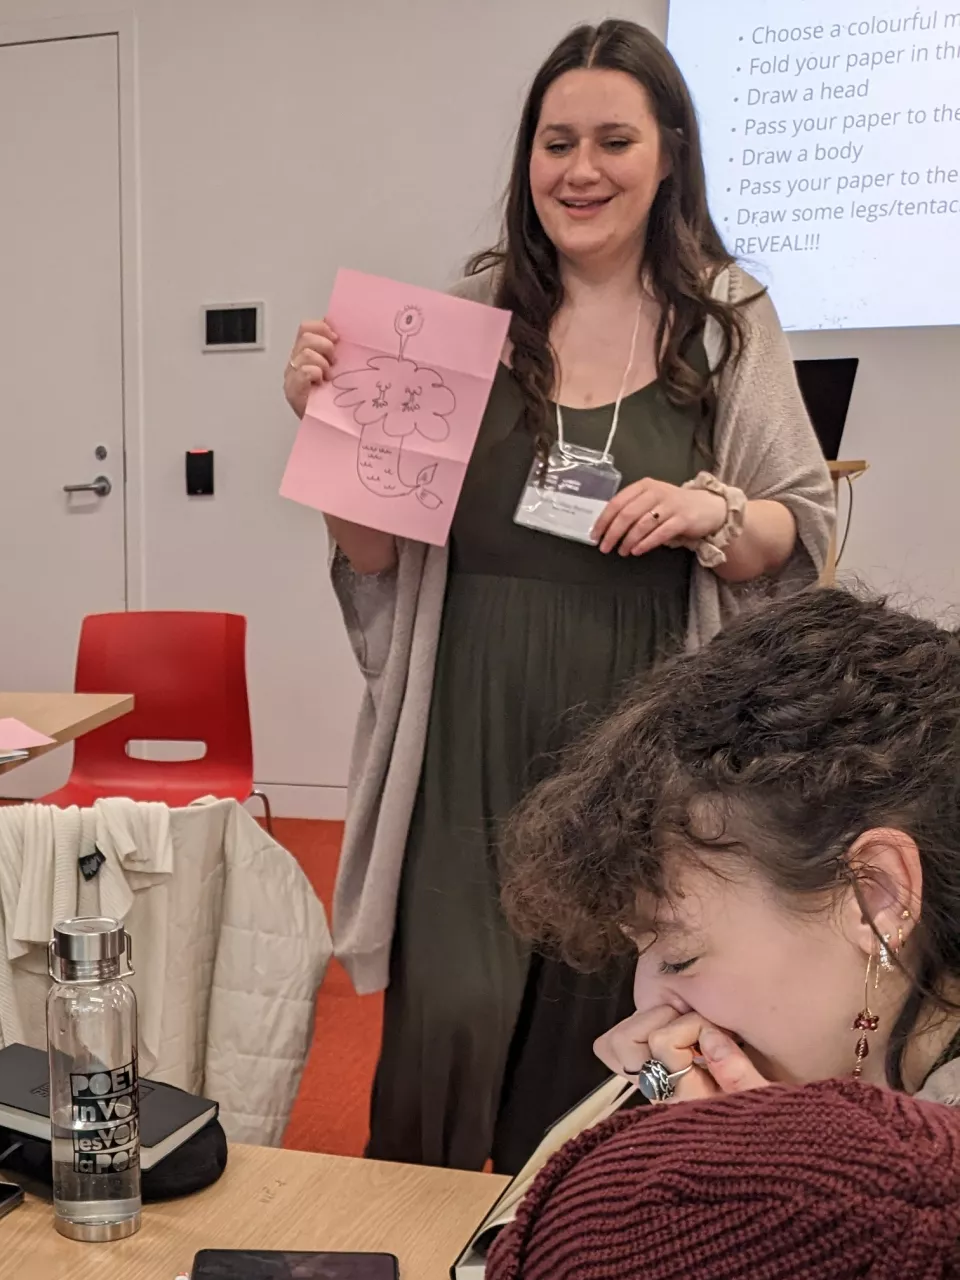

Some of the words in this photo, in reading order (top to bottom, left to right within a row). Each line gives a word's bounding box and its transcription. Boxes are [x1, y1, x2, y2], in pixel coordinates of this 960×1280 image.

[751, 25, 824, 45] Choose
[829, 23, 841, 39] a
[847, 10, 938, 37] colourful
[749, 54, 790, 76] Fold
[793, 54, 841, 77] your
[845, 49, 906, 73] paper
[910, 43, 929, 63] in
[747, 87, 798, 106] Draw
[802, 86, 814, 102] a
[820, 78, 870, 100] head
[744, 118, 788, 136] Pass
[791, 115, 838, 138] your
[842, 111, 902, 134] paper
[907, 108, 927, 125] to
[741, 148, 792, 167] Draw
[797, 147, 808, 163] a
[814, 141, 864, 164] body
[739, 178, 782, 197] Pass
[785, 175, 832, 198] your
[836, 172, 895, 195] paper
[900, 168, 921, 187] to
[926, 165, 959, 185] the
[736, 207, 787, 227] Draw
[791, 204, 845, 224] some
[851, 198, 960, 223] legs/tentac
[734, 233, 820, 256] REVEAL!!!
